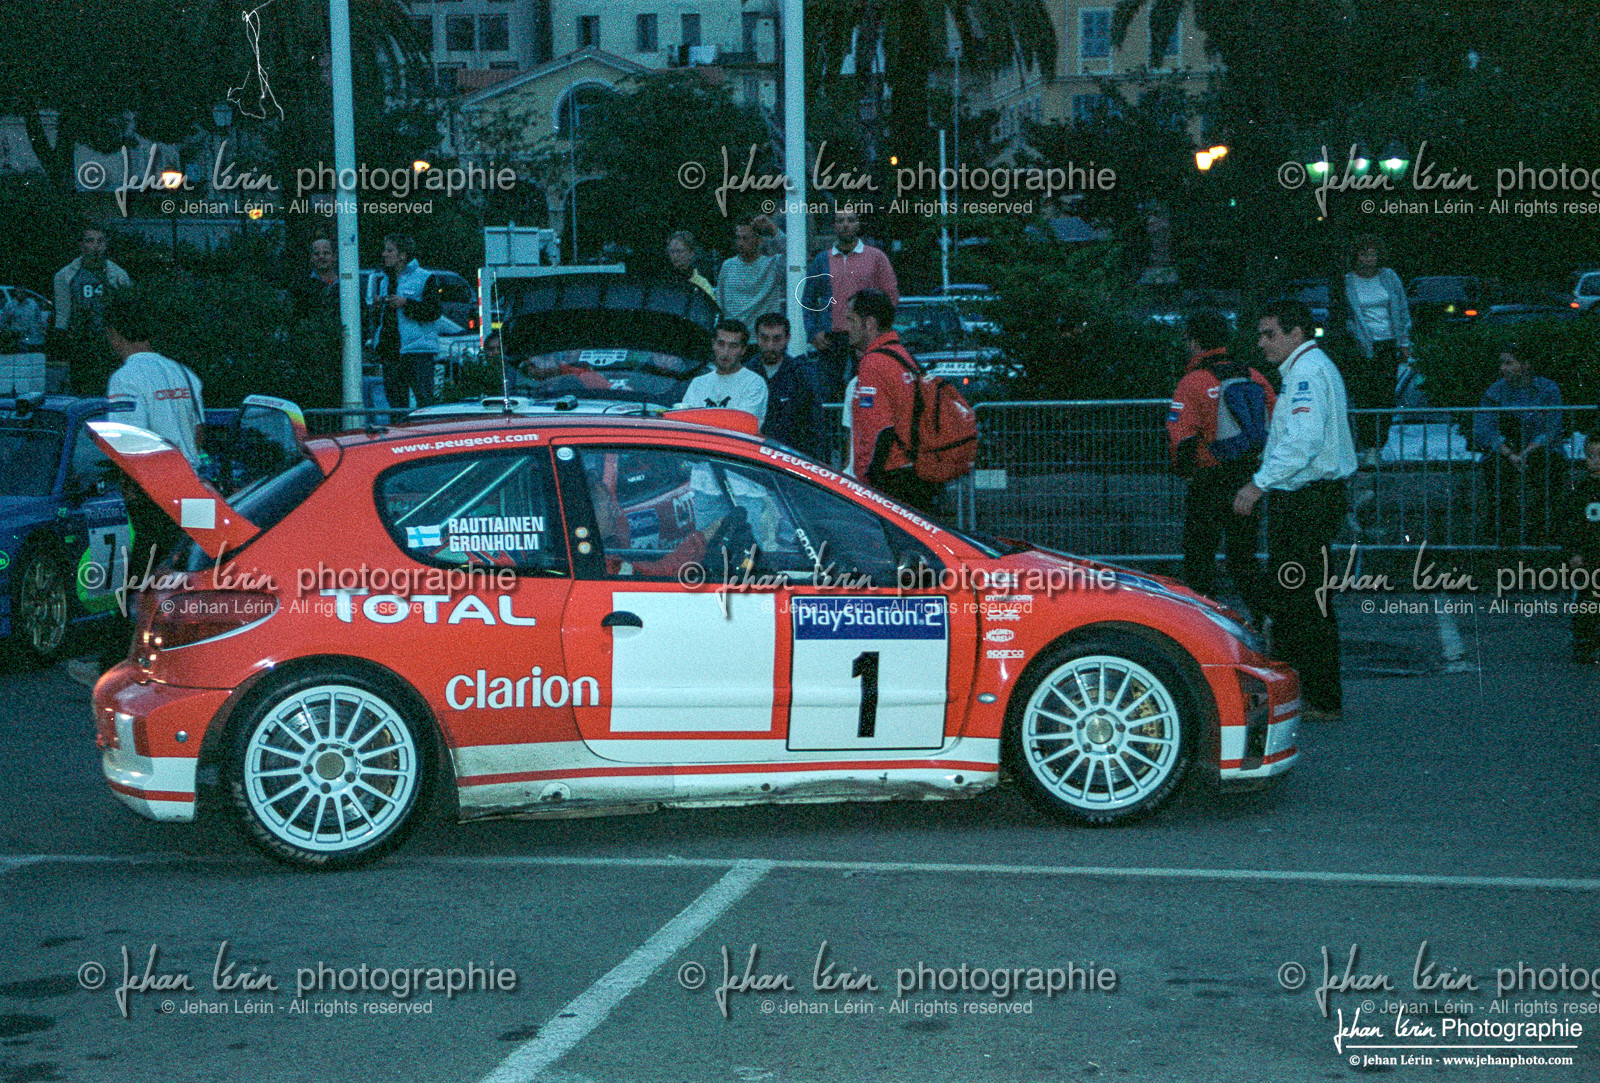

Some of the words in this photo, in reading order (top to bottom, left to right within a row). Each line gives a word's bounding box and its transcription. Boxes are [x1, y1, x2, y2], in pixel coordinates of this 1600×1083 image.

[391, 432, 539, 455] www.peugeot.com
[771, 449, 839, 482] PEUGEOT
[838, 476, 942, 535] FINANCEMENT
[448, 516, 545, 534] RAUTIAINEN
[449, 533, 540, 553] GRONHOLM
[103, 533, 117, 589] 7
[320, 588, 537, 627] TOTAL
[986, 650, 1024, 658] sparco
[852, 651, 880, 738] 1
